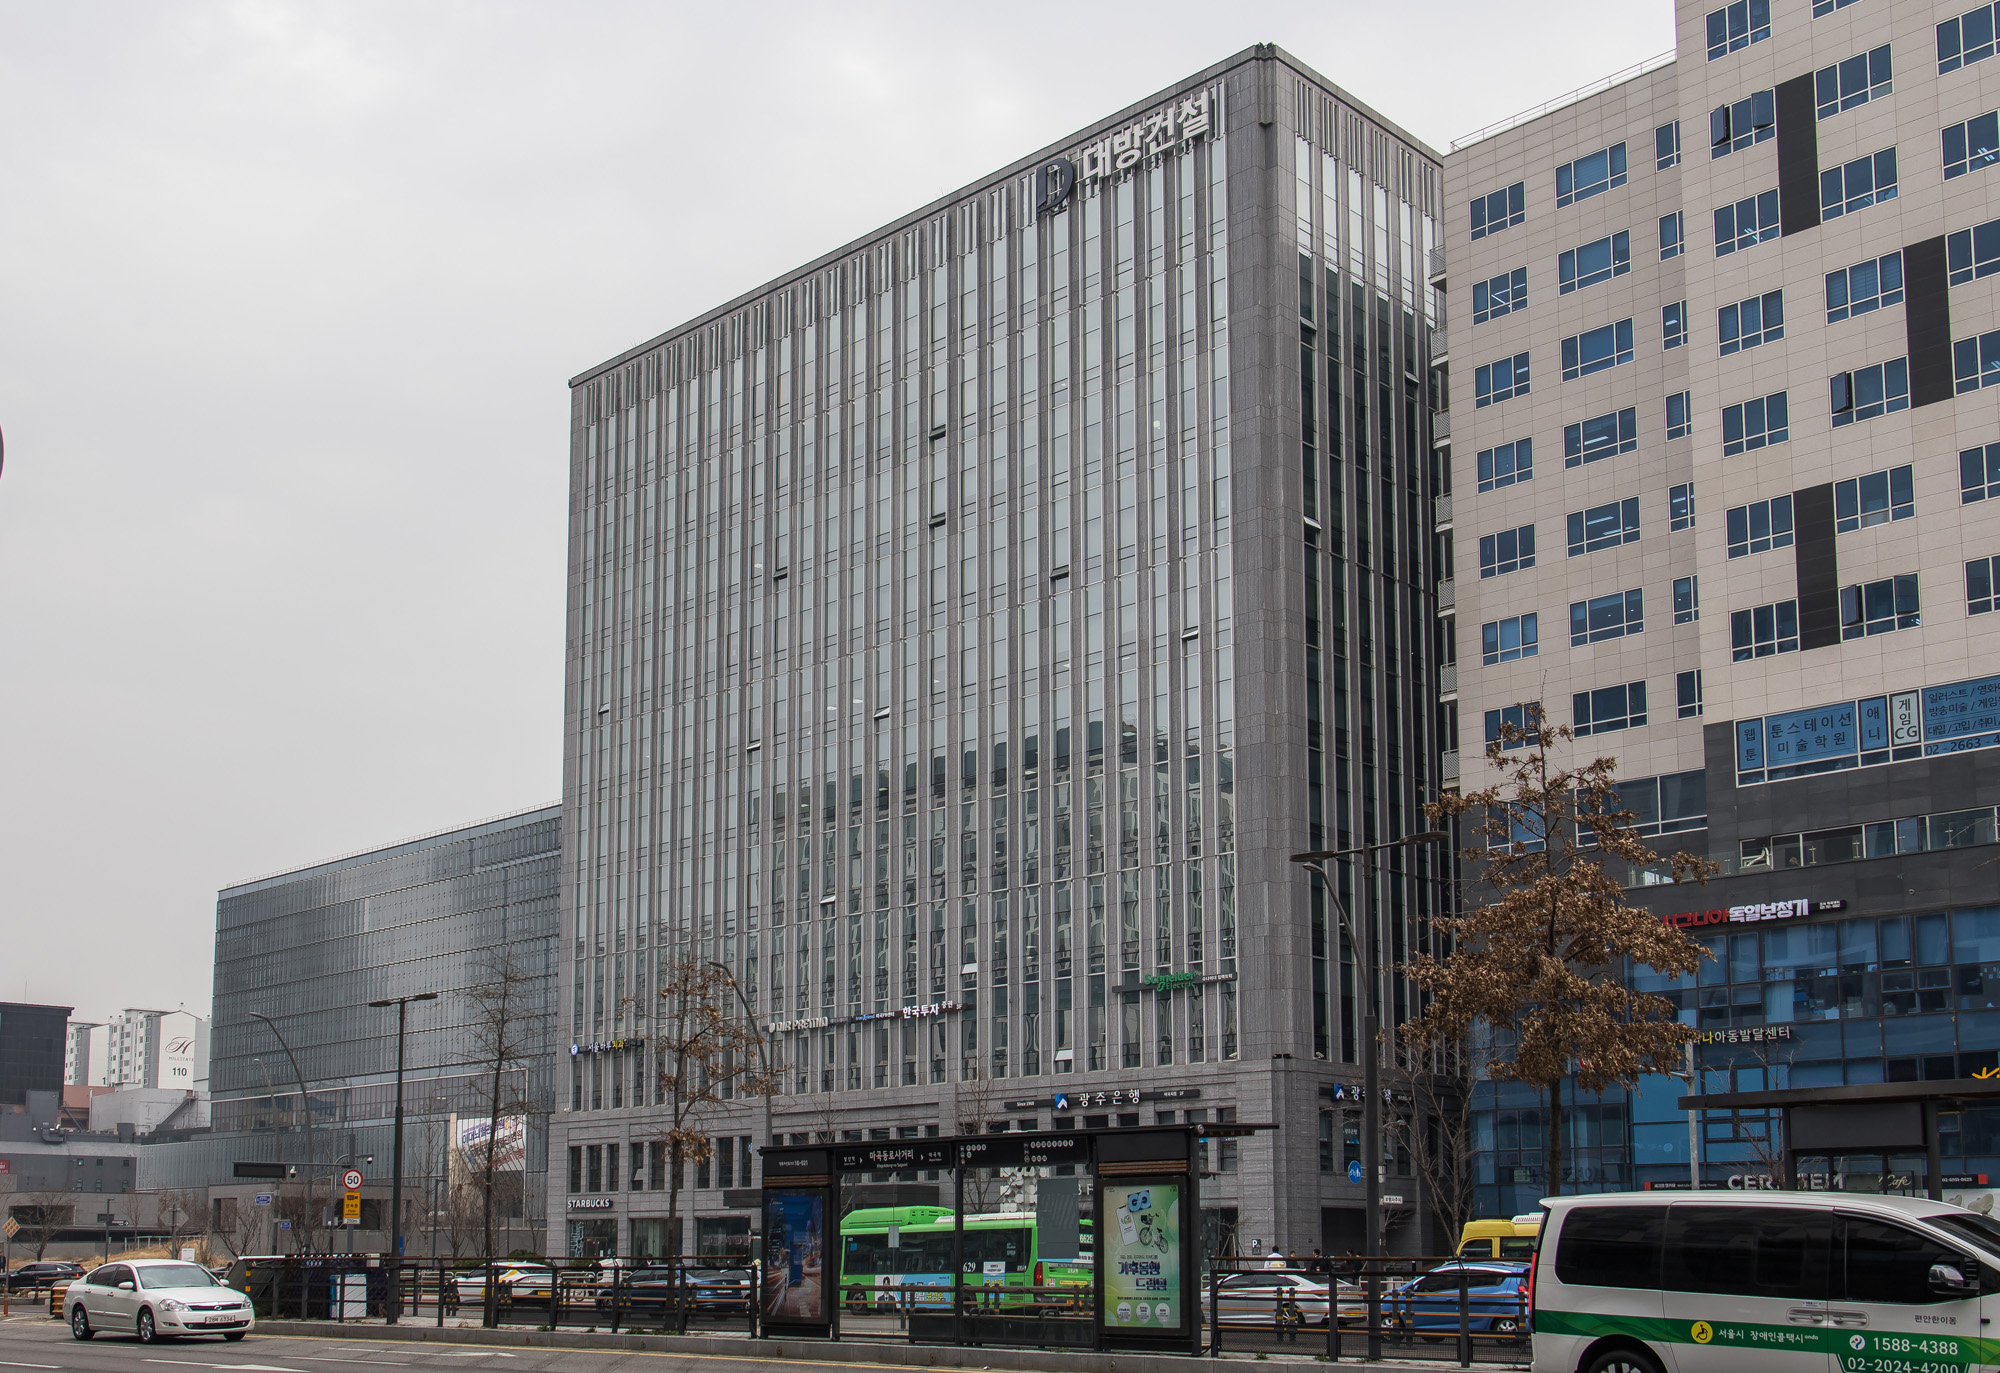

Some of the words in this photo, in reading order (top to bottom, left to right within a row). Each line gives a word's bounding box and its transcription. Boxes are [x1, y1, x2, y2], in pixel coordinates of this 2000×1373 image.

[1082, 91, 1209, 179] 대방건설
[1928, 688, 1969, 704] 일러스트
[1977, 682, 2000, 696] 영화
[1928, 702, 1968, 718] 방송미술
[1894, 725, 1918, 740] CG
[1144, 970, 1196, 985] Schneider
[1165, 981, 1196, 990] Electric
[903, 1002, 940, 1019] 한국투자
[776, 1019, 792, 1032] AIR
[792, 1016, 829, 1030] PREMIA
[172, 1067, 188, 1077] 110
[1078, 1088, 1140, 1107] 광주은행
[869, 1149, 914, 1162] 마곡동로사거리
[346, 1175, 360, 1185] 50
[567, 1198, 610, 1208] STARBUCKS
[1914, 1314, 1957, 1325] 편안한이동
[1718, 1328, 1745, 1340] 서울시
[1750, 1330, 1804, 1344] 장애인콜택시
[1873, 1337, 1959, 1356] 1588-4388
[1847, 1356, 1959, 1373] 02-2024-4200
